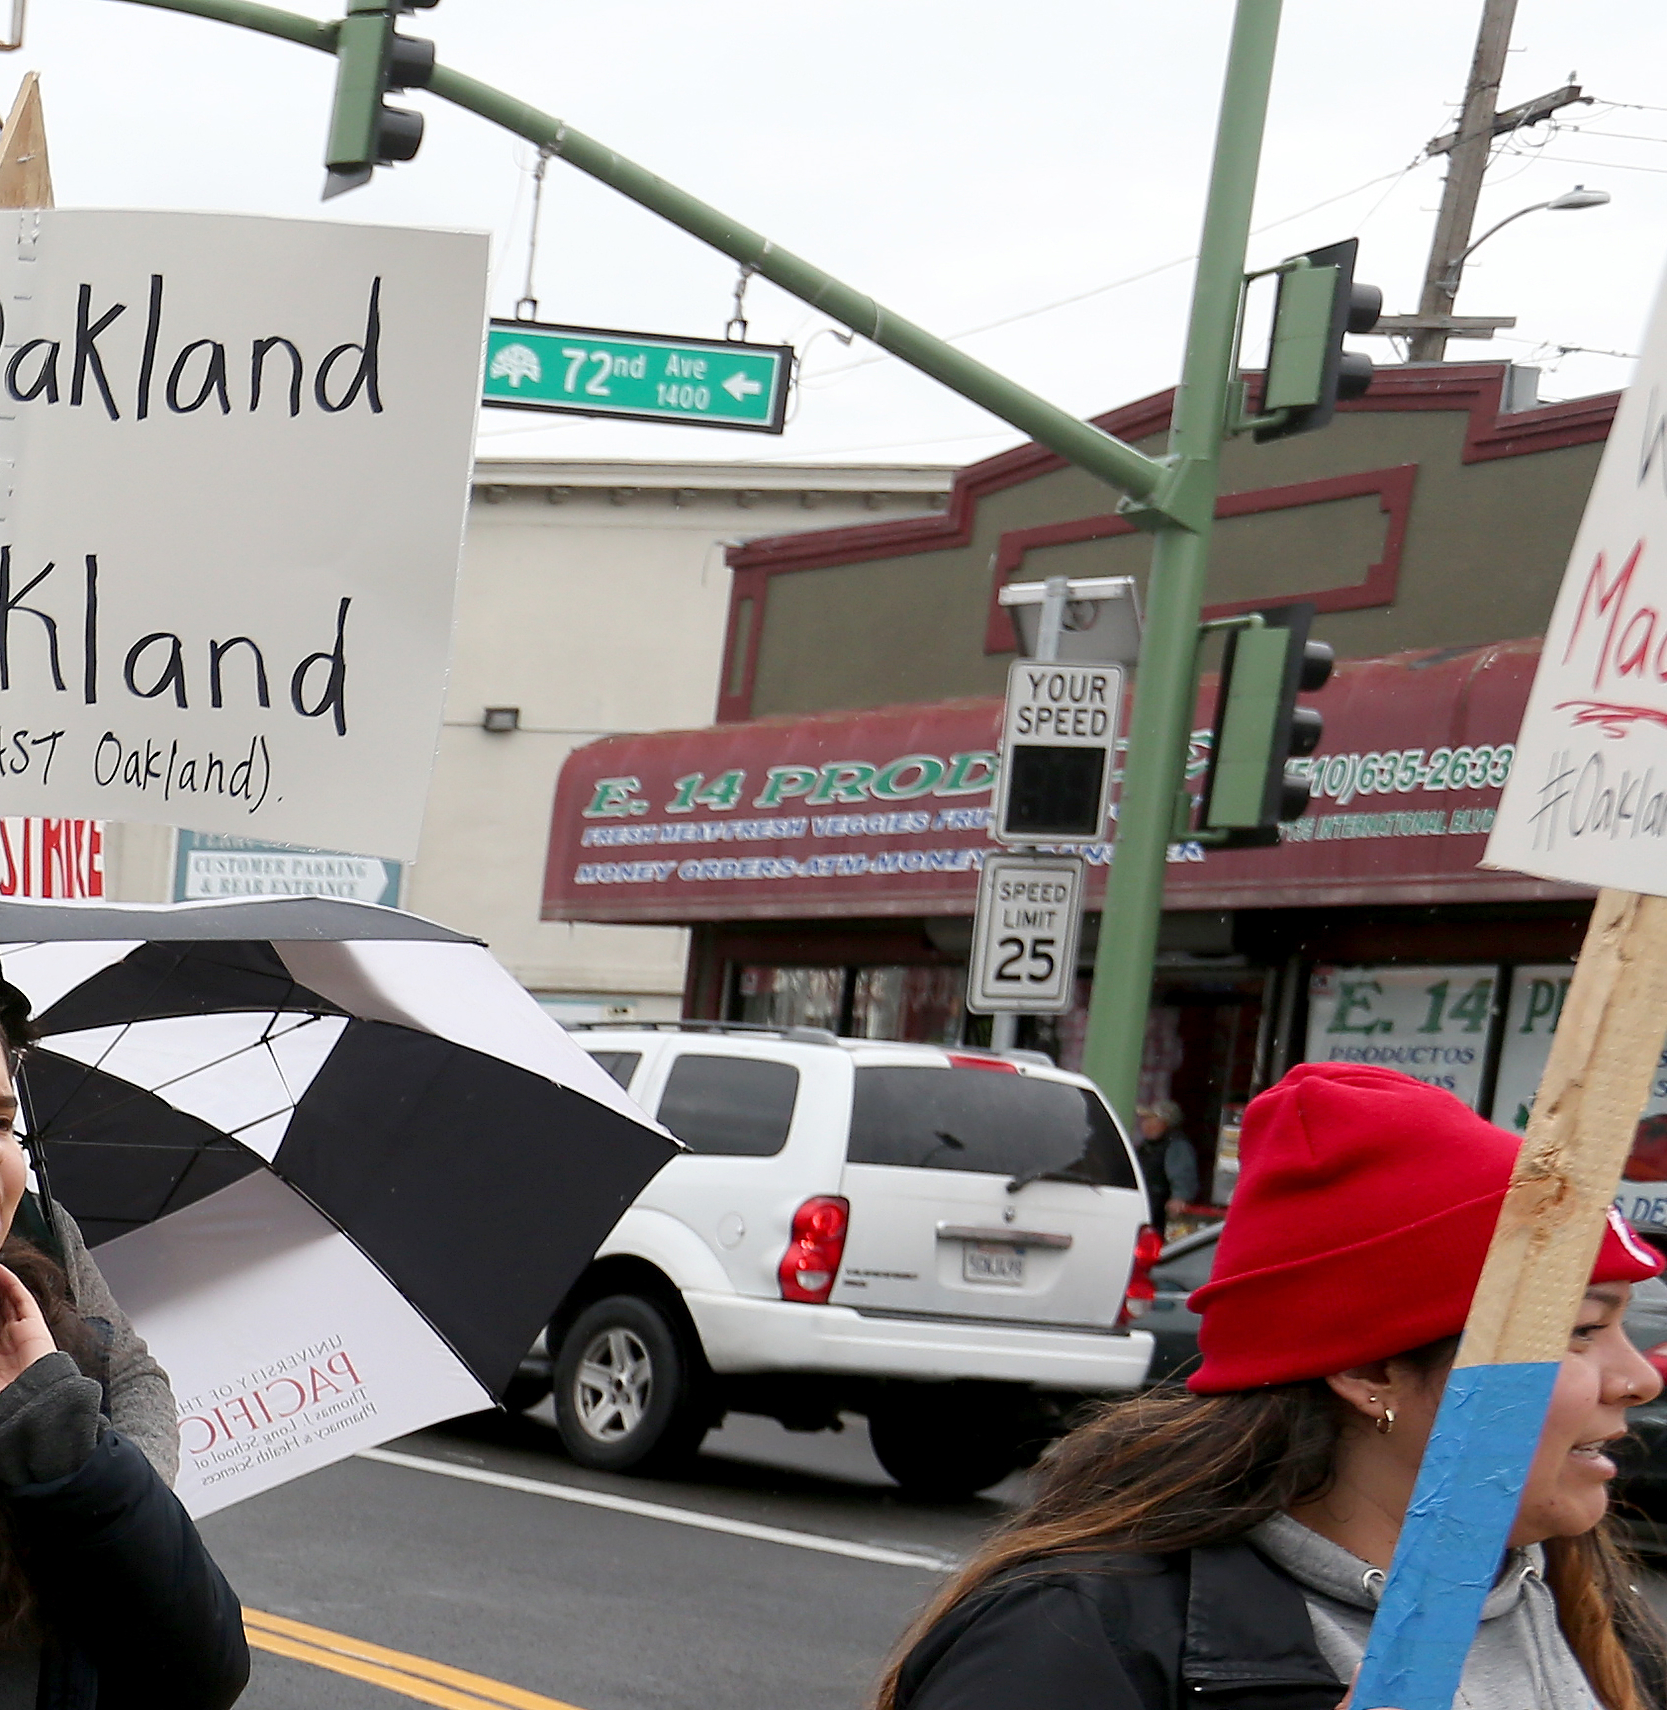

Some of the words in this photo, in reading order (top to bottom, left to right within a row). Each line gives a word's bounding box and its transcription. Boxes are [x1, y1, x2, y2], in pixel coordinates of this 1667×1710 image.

[562, 348, 647, 397] 72nd
[666, 352, 708, 380] Ave
[657, 383, 710, 410] 1400
[1027, 672, 1107, 703] YOUR
[1017, 706, 1108, 737] SPEED
[582, 776, 650, 818] E.
[664, 768, 747, 813] 14
[574, 861, 677, 884] MONEY
[999, 881, 1067, 902] SPEED
[1003, 909, 1058, 929] LIMIT
[995, 937, 1056, 982] 25
[1325, 979, 1395, 1035] E.
[1417, 977, 1494, 1034] 14
[1329, 1045, 1476, 1063] PRODUCTOS
